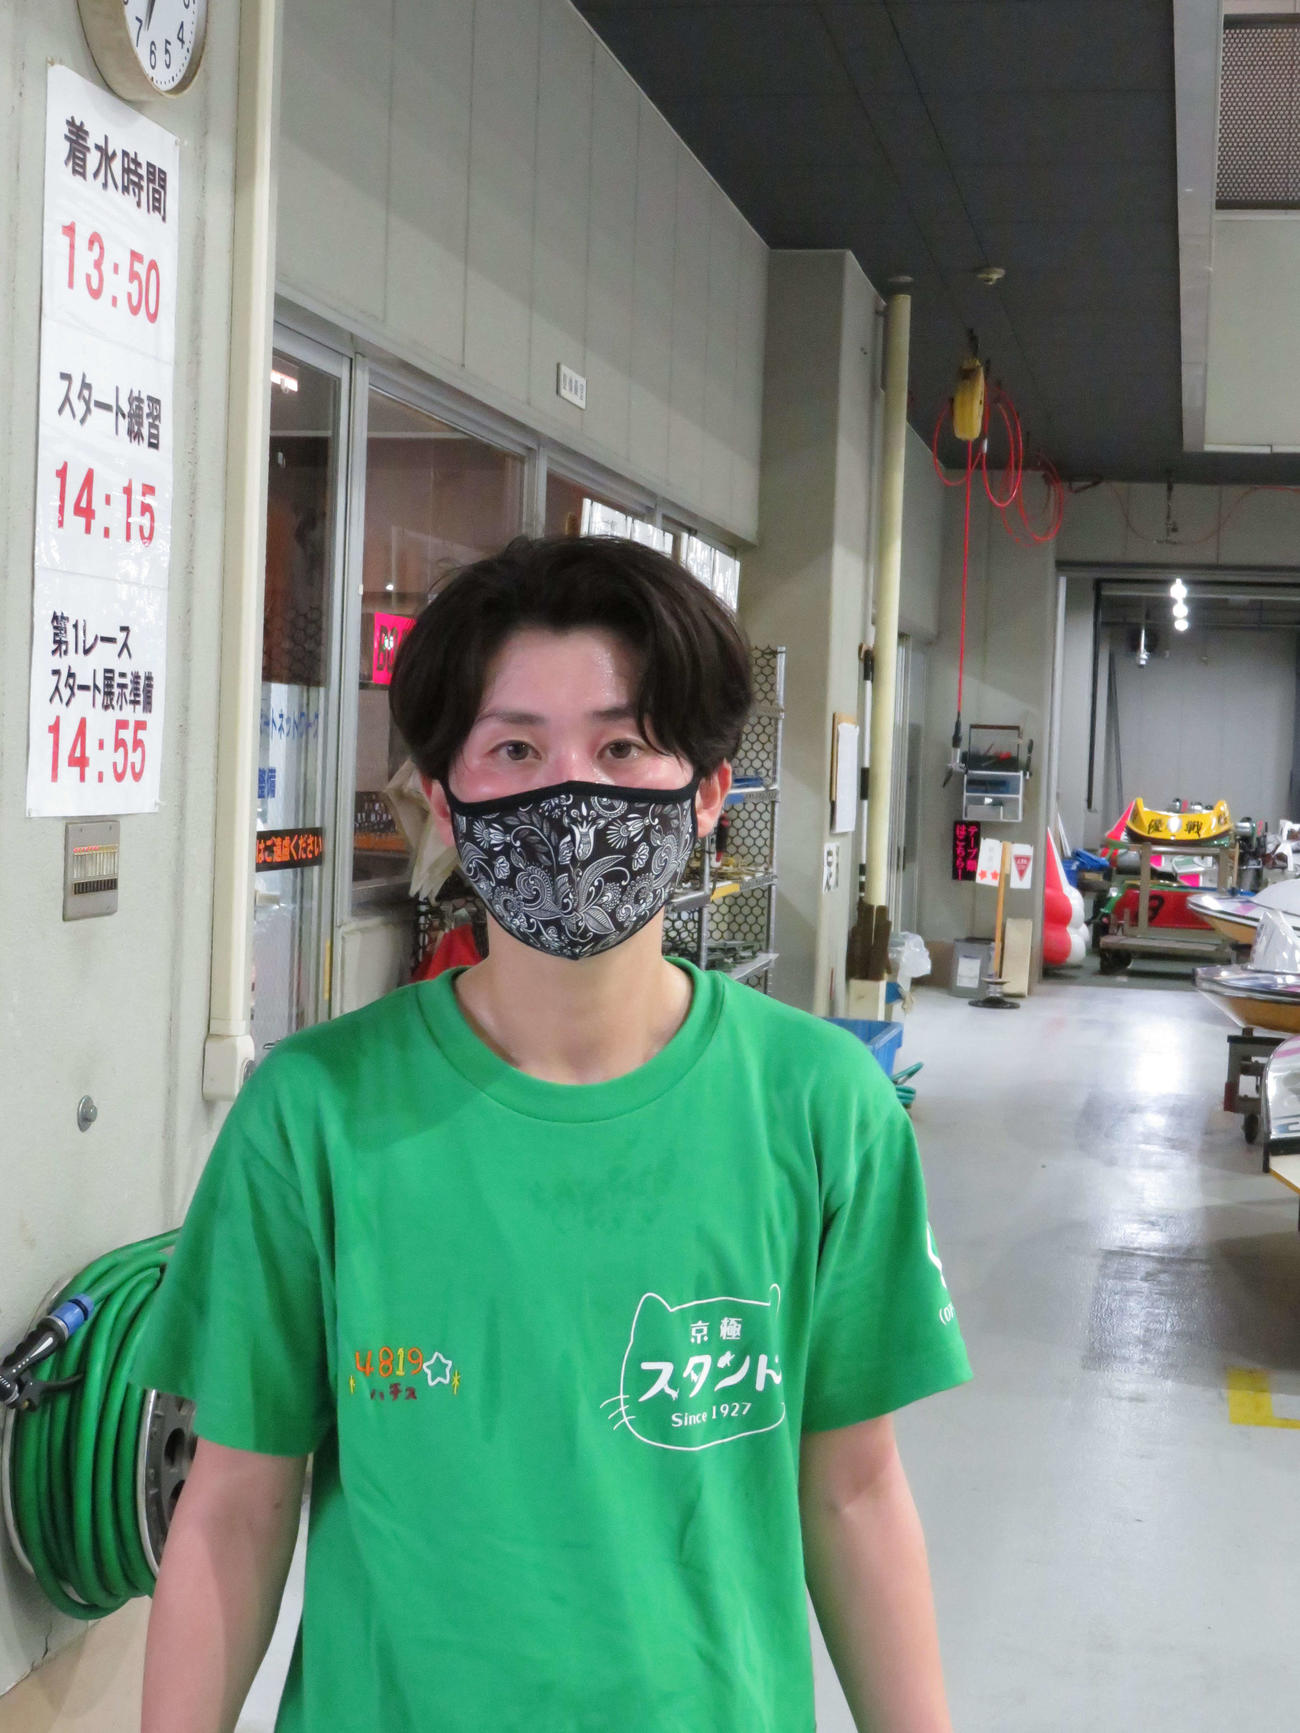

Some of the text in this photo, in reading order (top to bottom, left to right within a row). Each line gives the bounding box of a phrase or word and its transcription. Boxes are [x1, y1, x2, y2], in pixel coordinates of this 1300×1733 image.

[135, 16, 143, 48] 7
[177, 21, 185, 49] 4
[149, 40, 157, 70] 6
[164, 38, 171, 69] 5
[64, 115, 168, 223] 着水時間
[61, 221, 160, 324] 13:50
[58, 372, 161, 451] スタート練習
[55, 461, 156, 547] 14:15
[51, 610, 132, 659] 第1レース
[49, 665, 154, 714] スタート展示準備
[48, 715, 148, 784] 14:55
[690, 1317, 743, 1344] 京極
[355, 1346, 424, 1378] 4819
[671, 1402, 752, 1428] Since 1927
